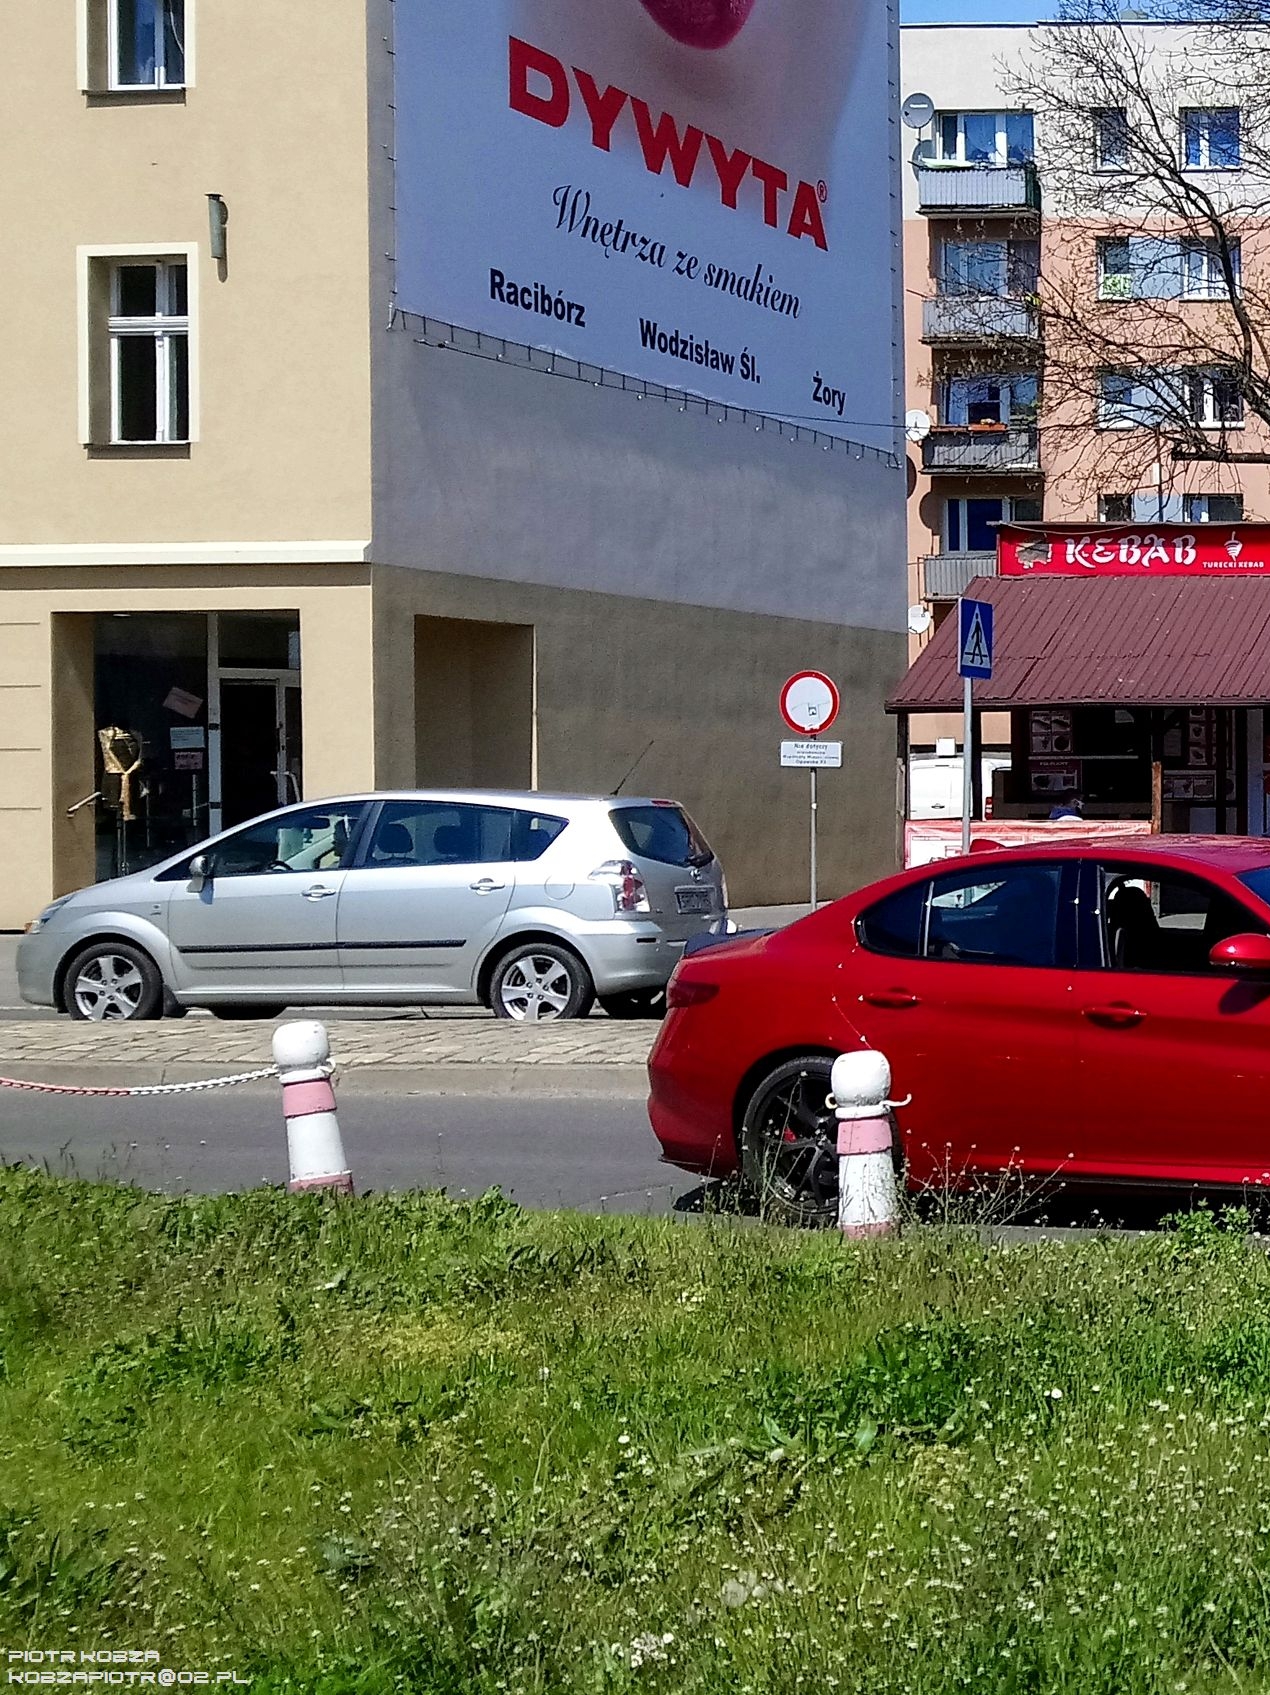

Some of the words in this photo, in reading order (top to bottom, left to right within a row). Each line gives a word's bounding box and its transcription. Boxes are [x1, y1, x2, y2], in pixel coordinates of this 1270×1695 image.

[552, 184, 666, 268] Wnętrza
[672, 248, 701, 280] ze
[703, 263, 802, 319] smakiem
[489, 267, 587, 328] Racibórz
[638, 317, 736, 375] Wodzisław
[739, 346, 761, 384] Śl.
[812, 370, 846, 416] Żory
[1064, 533, 1197, 568] KEBAB
